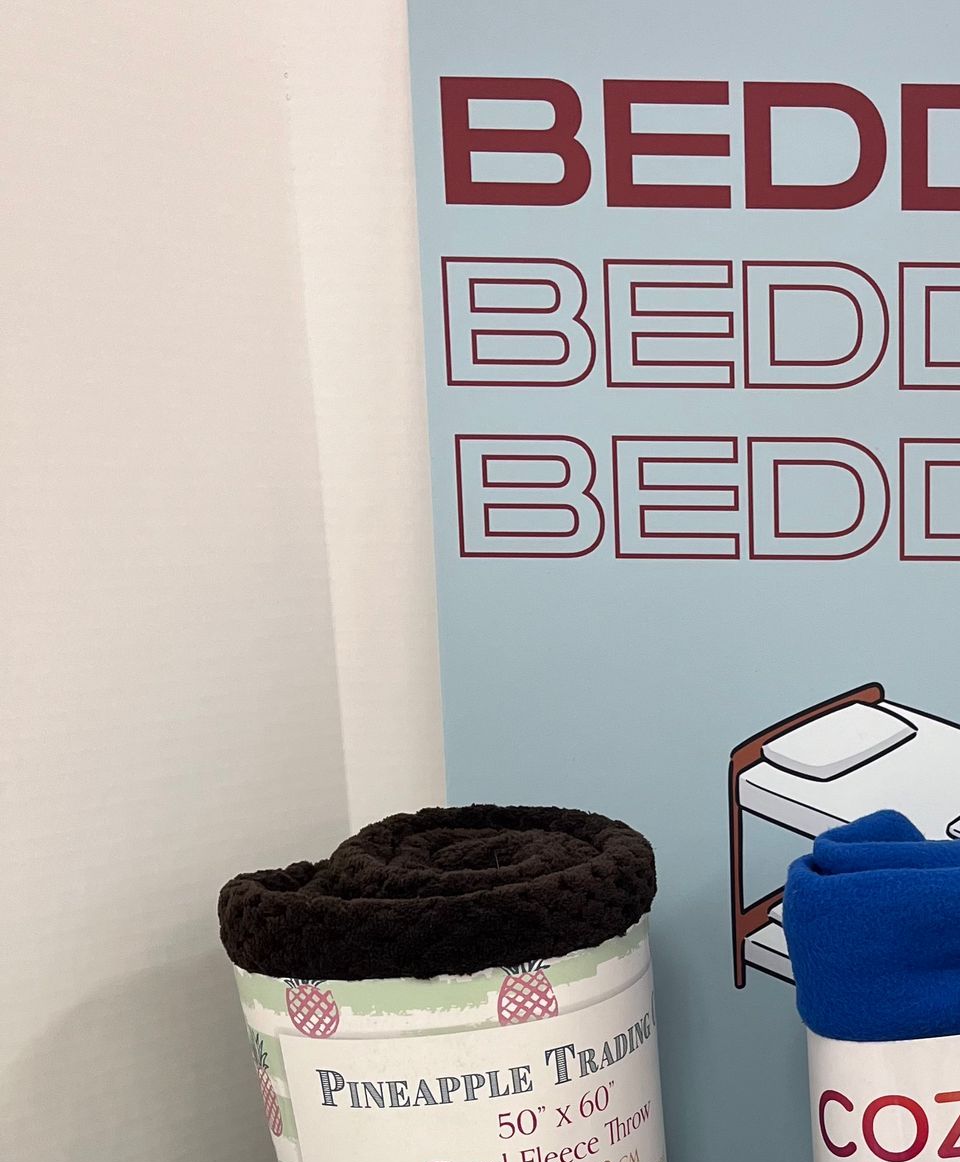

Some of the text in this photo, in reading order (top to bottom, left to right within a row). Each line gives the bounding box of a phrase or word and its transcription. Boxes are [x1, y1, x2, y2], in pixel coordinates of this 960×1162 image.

[315, 1012, 651, 1109] PINEAPPLE TRADING
[604, 1100, 652, 1146] Throw
